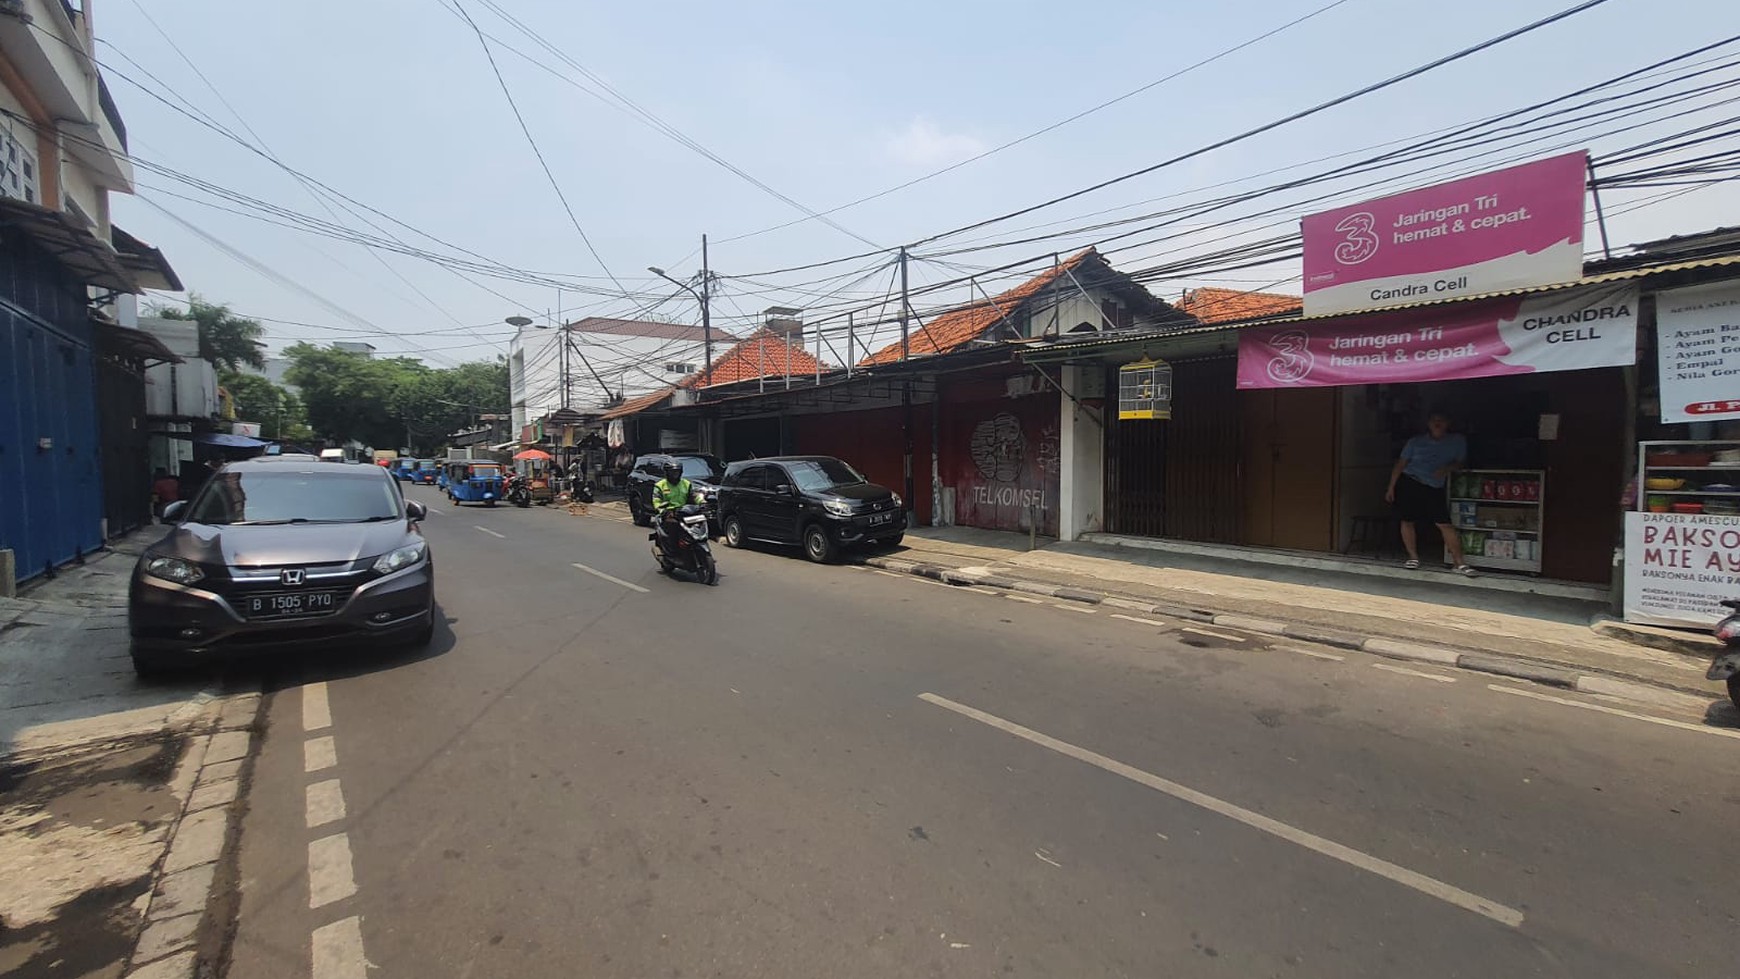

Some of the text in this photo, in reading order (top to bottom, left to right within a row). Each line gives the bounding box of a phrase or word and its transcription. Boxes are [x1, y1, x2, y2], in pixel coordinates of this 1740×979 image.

[1393, 193, 1498, 228] Jaringan Tri
[1393, 207, 1531, 244] hemat & cepat.
[1370, 276, 1467, 301] Candra Cell
[1523, 304, 1631, 331] CHANDRA
[1329, 326, 1443, 350] Jaringan Tri
[1546, 327, 1601, 344] CELL
[1675, 328, 1715, 339] Ayam
[1675, 338, 1715, 349] Ayam
[1329, 342, 1480, 367] hemat & cepat.
[1675, 349, 1716, 360] Ayam
[1676, 358, 1724, 370] Empal
[1677, 371, 1706, 380] Nila
[974, 486, 1048, 510] TELKOMSEL
[1643, 514, 1685, 524] DAPOER
[1643, 526, 1740, 549] BAKSO
[1643, 548, 1692, 568] MIE
[1698, 573, 1725, 584] ENAK
[253, 599, 262, 611] B
[271, 595, 301, 609] 1505
